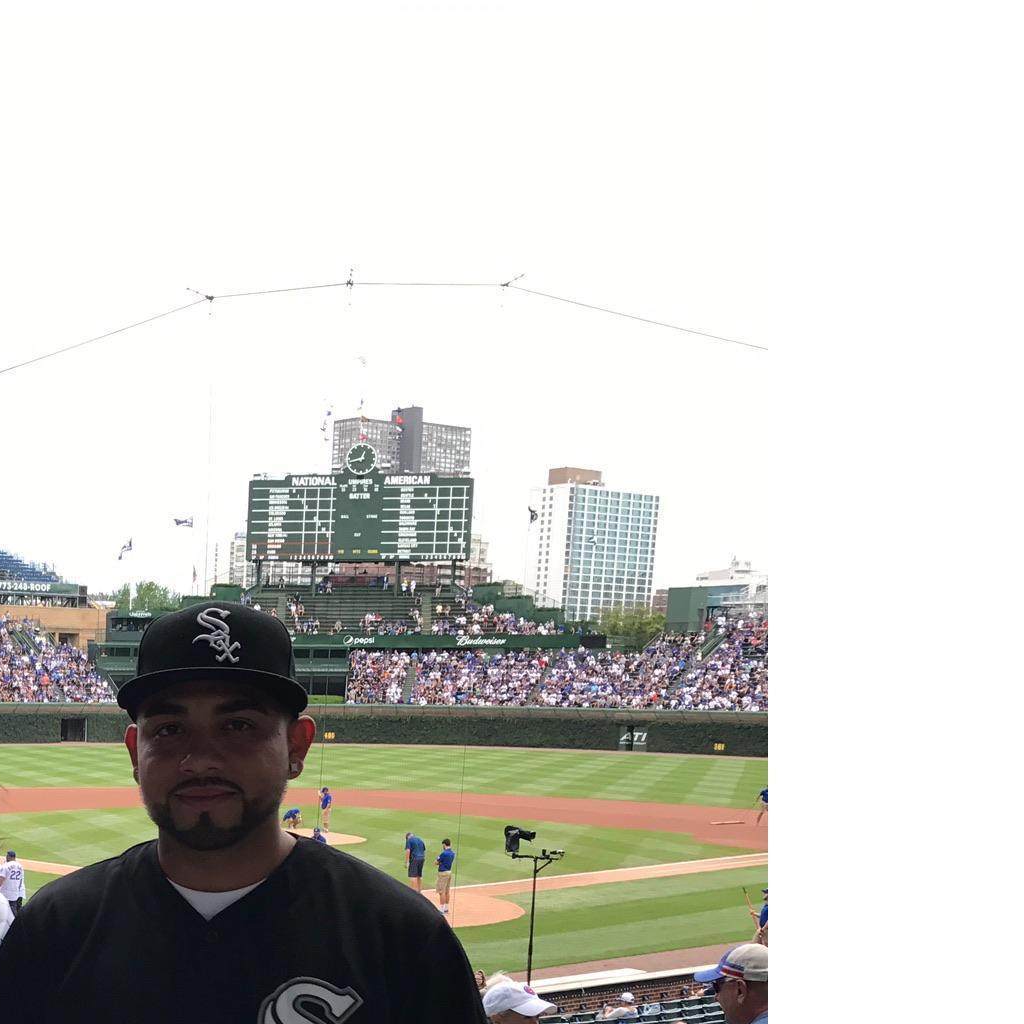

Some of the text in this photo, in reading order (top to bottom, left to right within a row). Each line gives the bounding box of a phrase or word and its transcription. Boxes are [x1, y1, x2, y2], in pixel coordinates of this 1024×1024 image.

[291, 476, 337, 486] NATIONAL
[384, 475, 430, 485] AMERICAN
[354, 636, 375, 645] pepsi
[456, 635, 507, 646] Budweiser
[619, 732, 647, 741] ATI
[10, 870, 21, 880] 22
